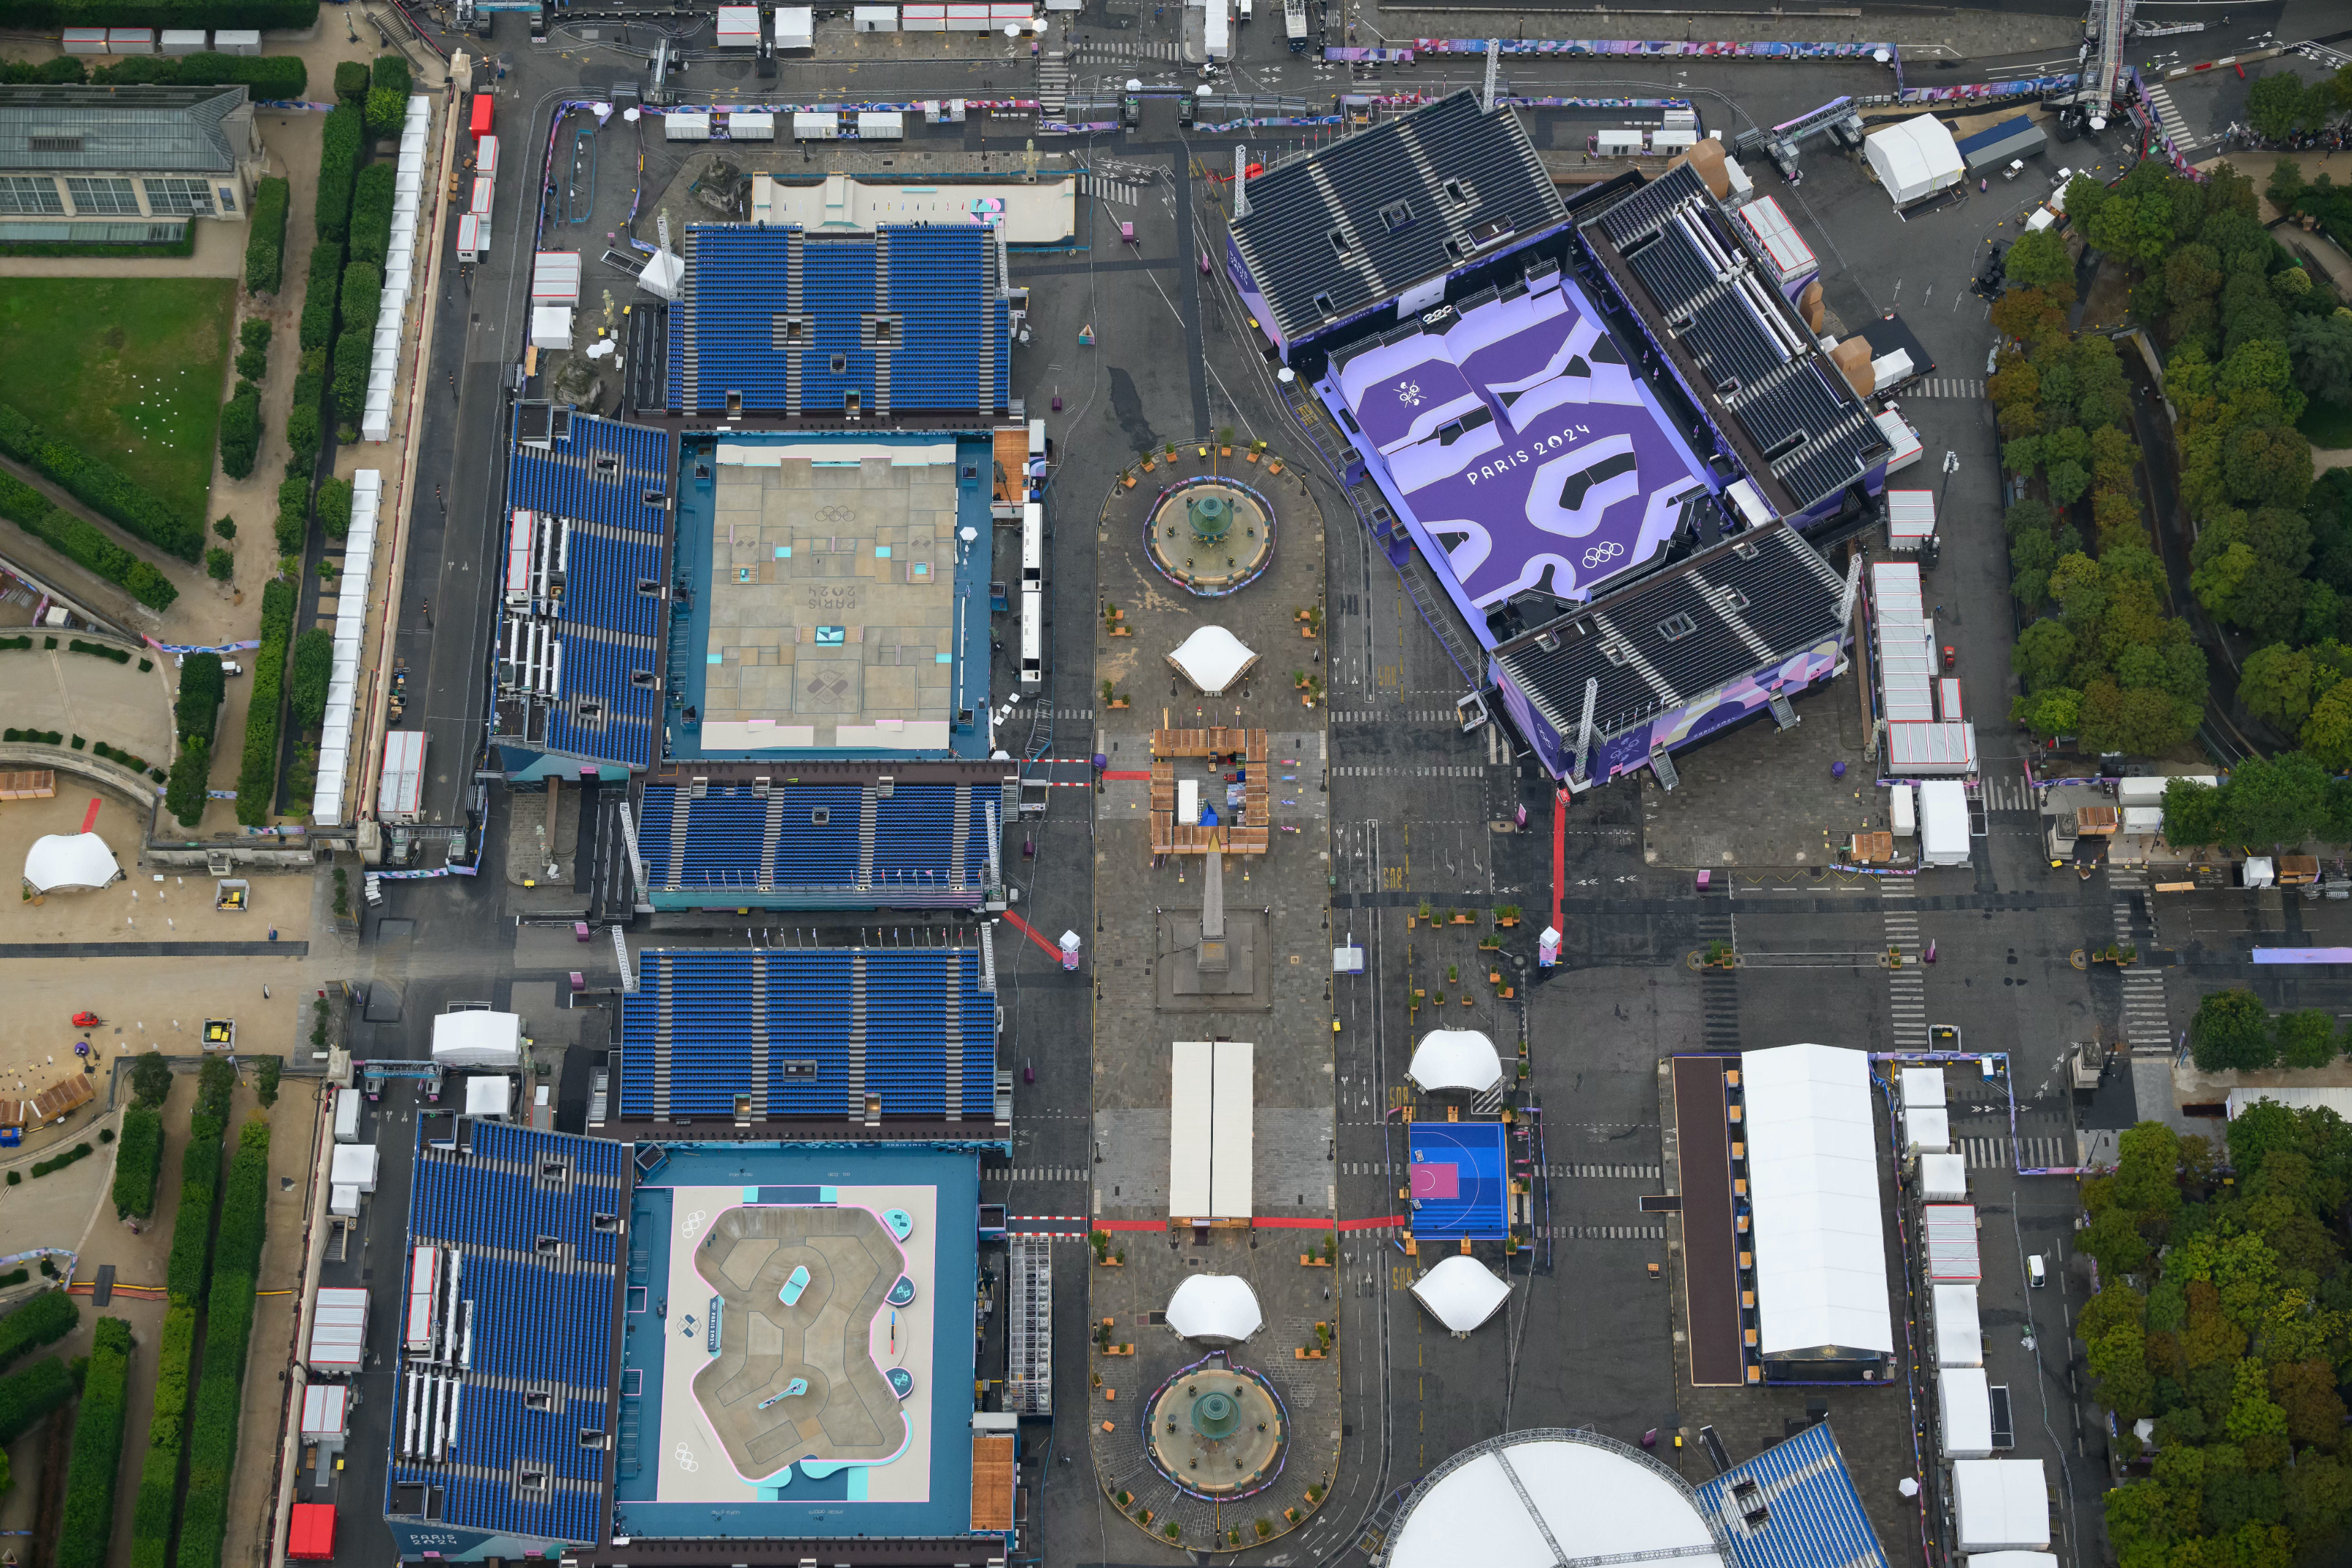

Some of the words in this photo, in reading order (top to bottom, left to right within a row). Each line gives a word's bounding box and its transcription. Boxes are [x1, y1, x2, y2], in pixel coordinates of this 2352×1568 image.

[1326, 10, 1341, 27] BUS
[1229, 249, 1248, 280] PARIS
[1534, 424, 1591, 453] 2024
[808, 586, 856, 597] 2024
[1378, 666, 1397, 686] BUS
[1389, 1086, 1408, 1109] BUS
